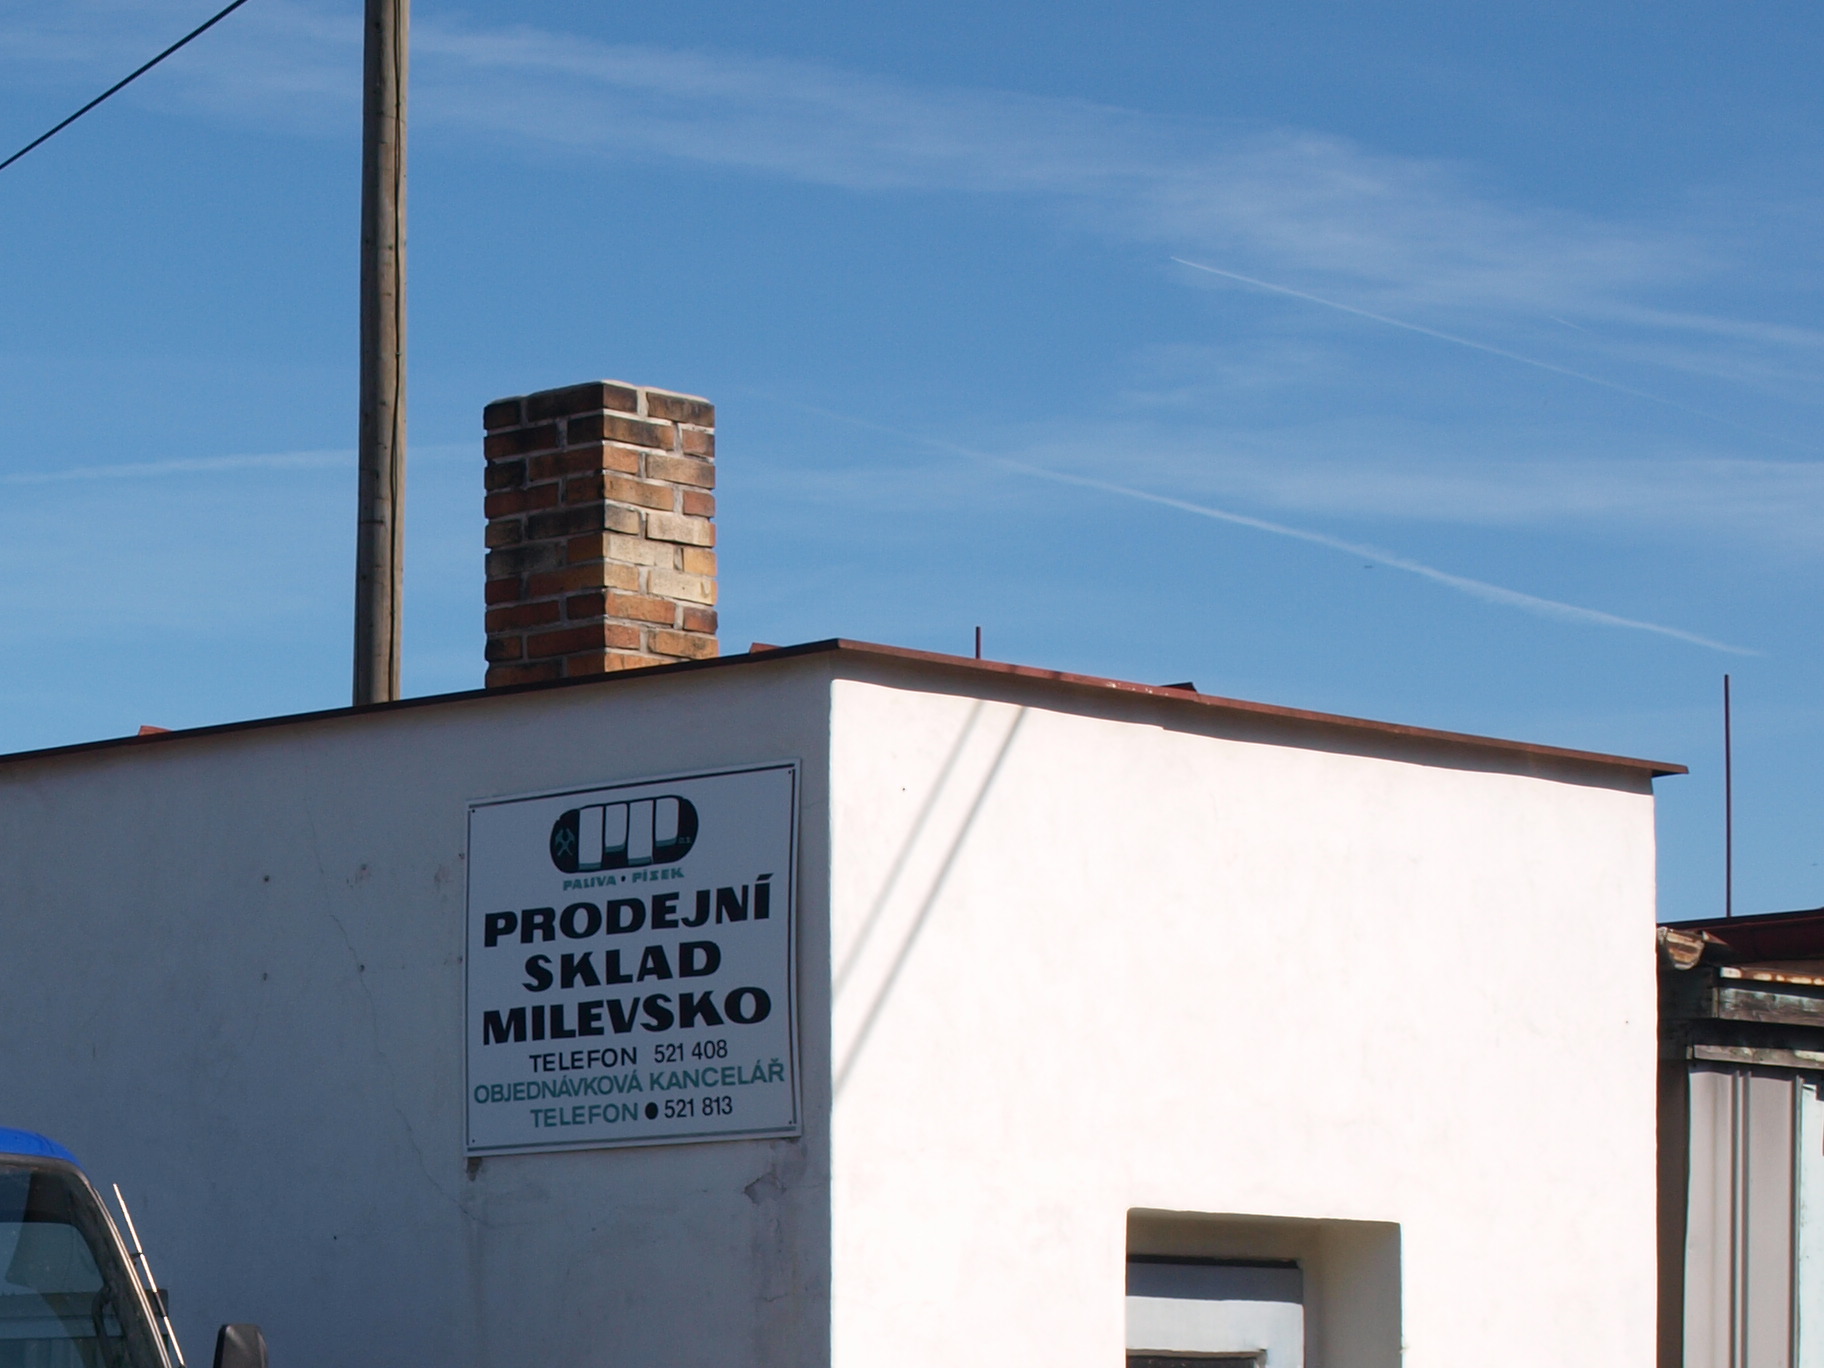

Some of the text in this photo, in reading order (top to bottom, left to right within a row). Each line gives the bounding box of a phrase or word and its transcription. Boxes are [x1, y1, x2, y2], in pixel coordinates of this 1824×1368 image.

[563, 867, 685, 891] PALIVA PÍSEK
[484, 873, 774, 947] PRODEJNÍ
[522, 940, 722, 992] SKLAD
[482, 986, 772, 1046] MILEVSKO
[529, 1039, 728, 1073] TELEFON 521 408
[473, 1058, 785, 1104] OBJEDNÁVKOVÁ KANCELÁŘ
[530, 1096, 733, 1129] TELEFON 521 813
